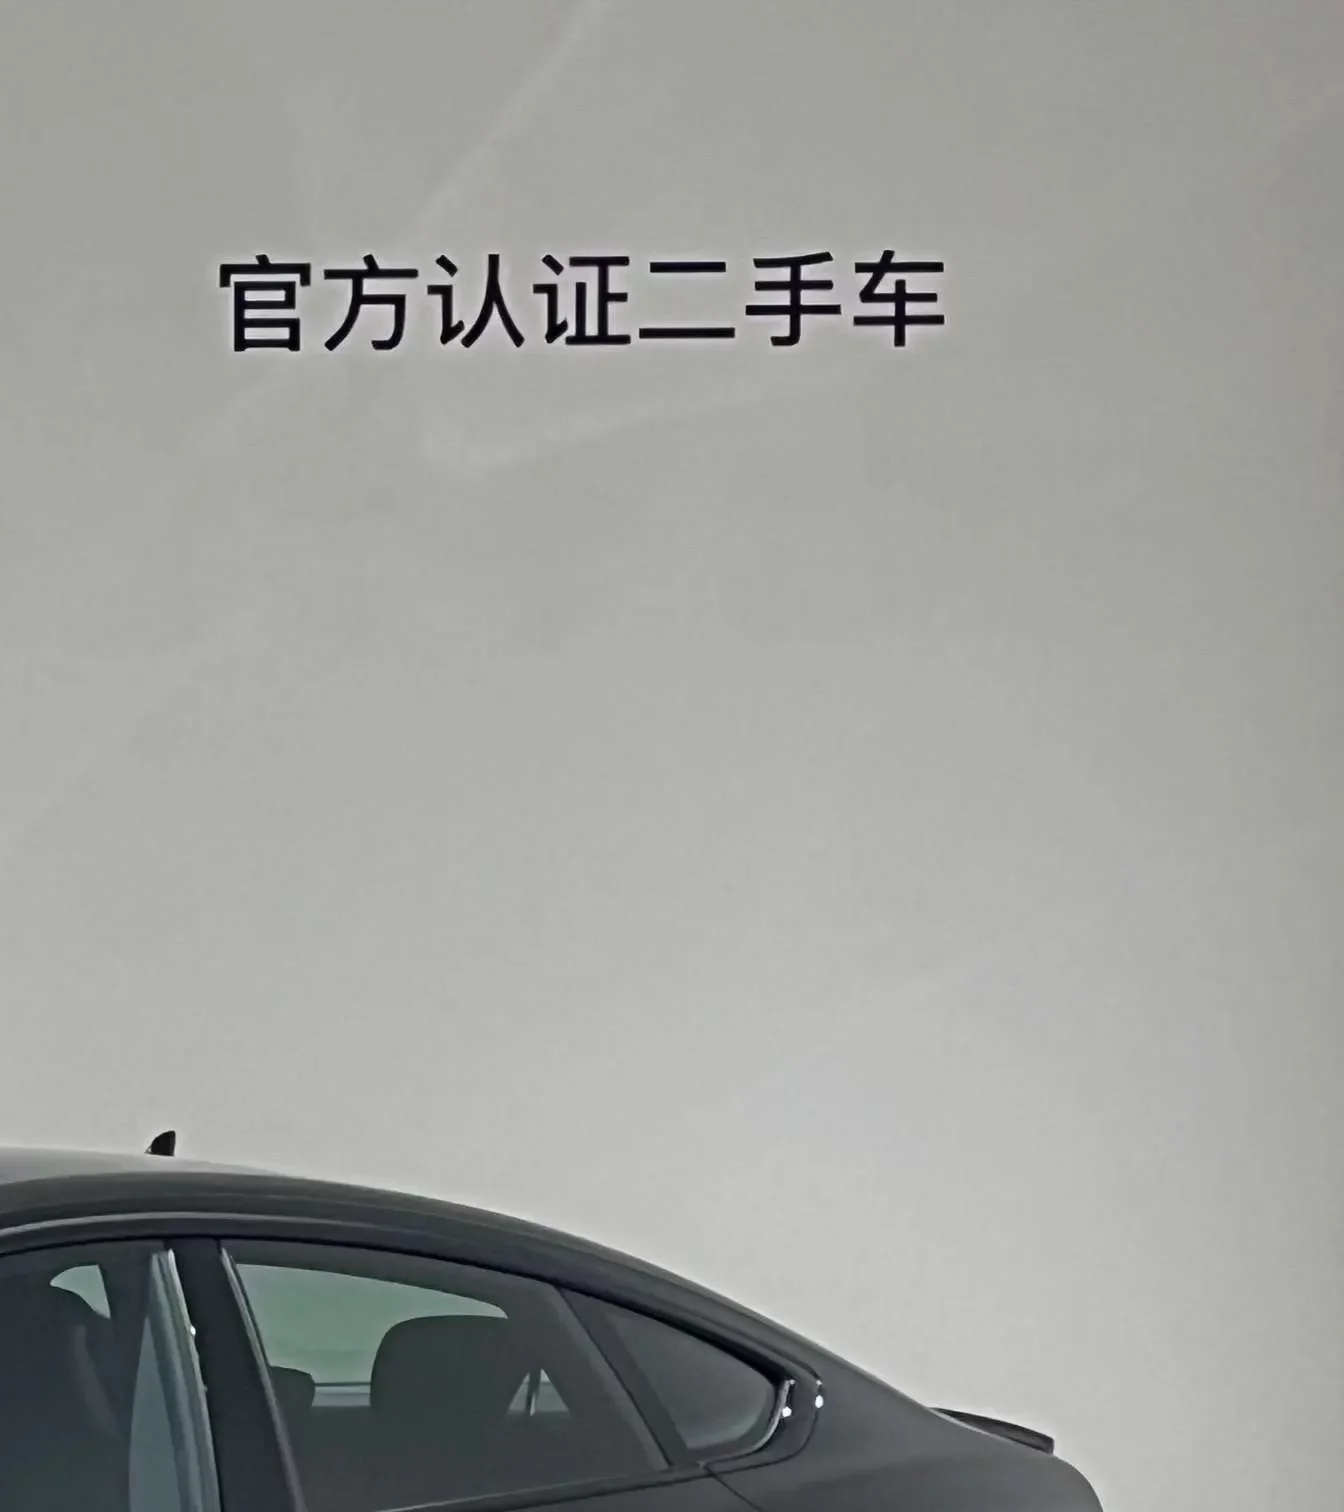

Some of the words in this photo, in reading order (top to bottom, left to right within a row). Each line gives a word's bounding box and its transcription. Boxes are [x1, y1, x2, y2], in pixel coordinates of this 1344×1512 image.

[218, 249, 946, 353] 官方认证二手车
